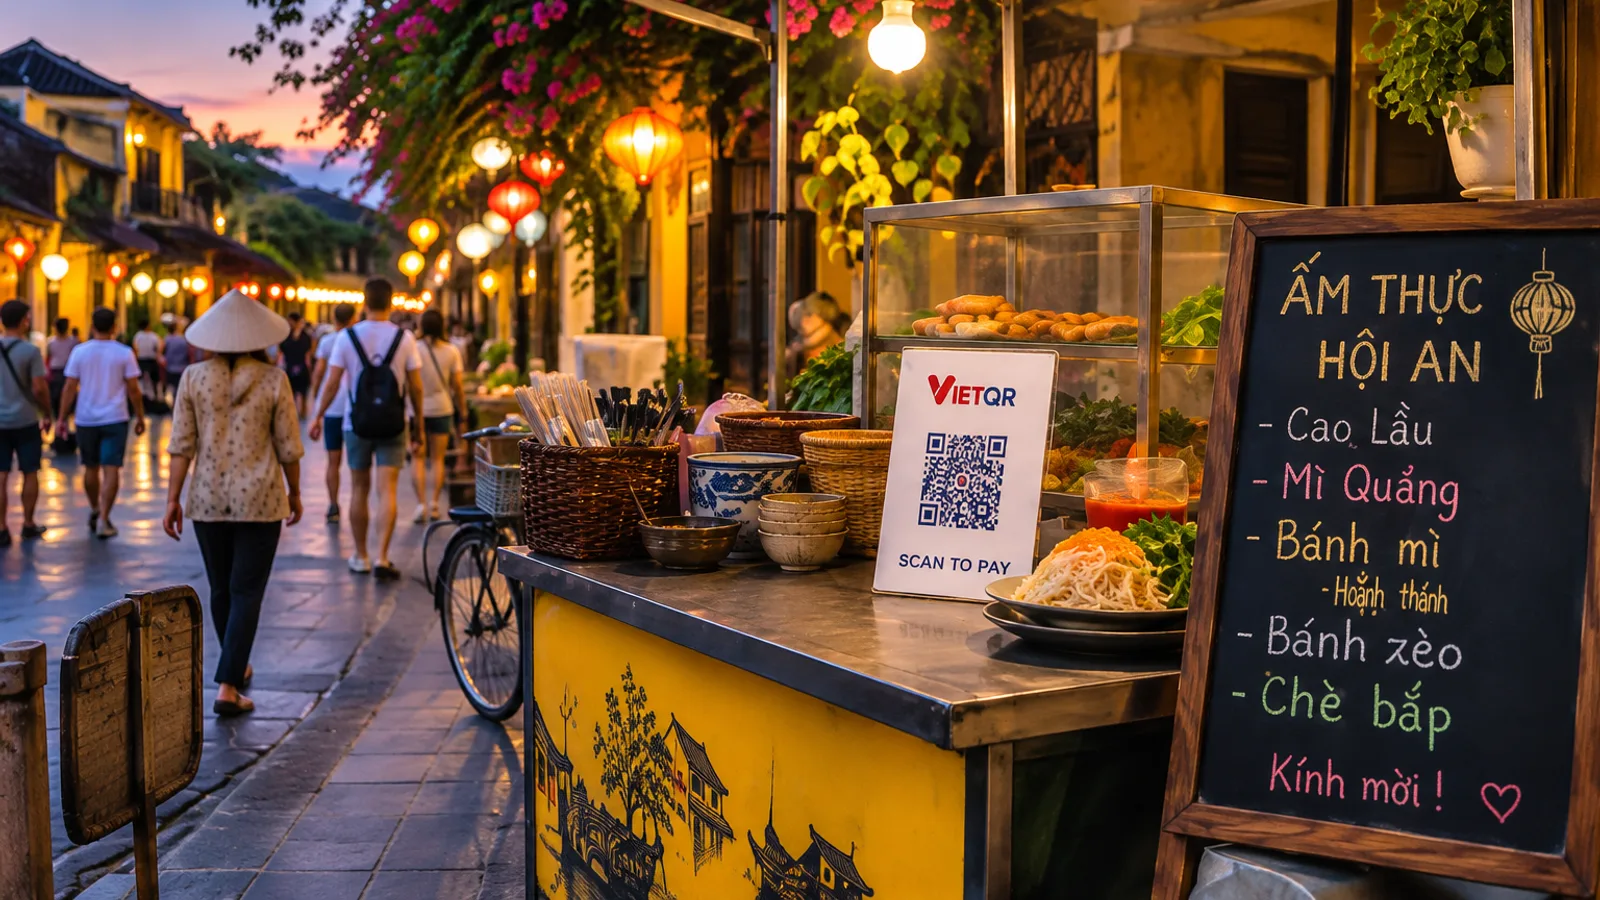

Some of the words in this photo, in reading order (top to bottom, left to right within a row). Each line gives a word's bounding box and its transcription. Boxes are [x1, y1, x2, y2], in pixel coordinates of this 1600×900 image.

[1280, 251, 1350, 315] ẤM
[1371, 268, 1483, 325] THỰC
[1318, 328, 1390, 390] HỘI
[1410, 340, 1481, 382] AN
[928, 374, 1016, 406] VIETQR
[1371, 401, 1433, 446] Lầu
[1282, 462, 1324, 501] Mì
[898, 553, 945, 571] SCAN
[950, 557, 973, 573] TO
[977, 559, 1012, 576] PAY
[1276, 518, 1369, 564] Bánh
[1398, 528, 1440, 569] mì
[1267, 615, 1366, 662] Bánh
[1262, 675, 1342, 723] Chè
[1372, 680, 1451, 751] bắp
[1269, 752, 1345, 799] Kính
[1362, 768, 1420, 808] mời
